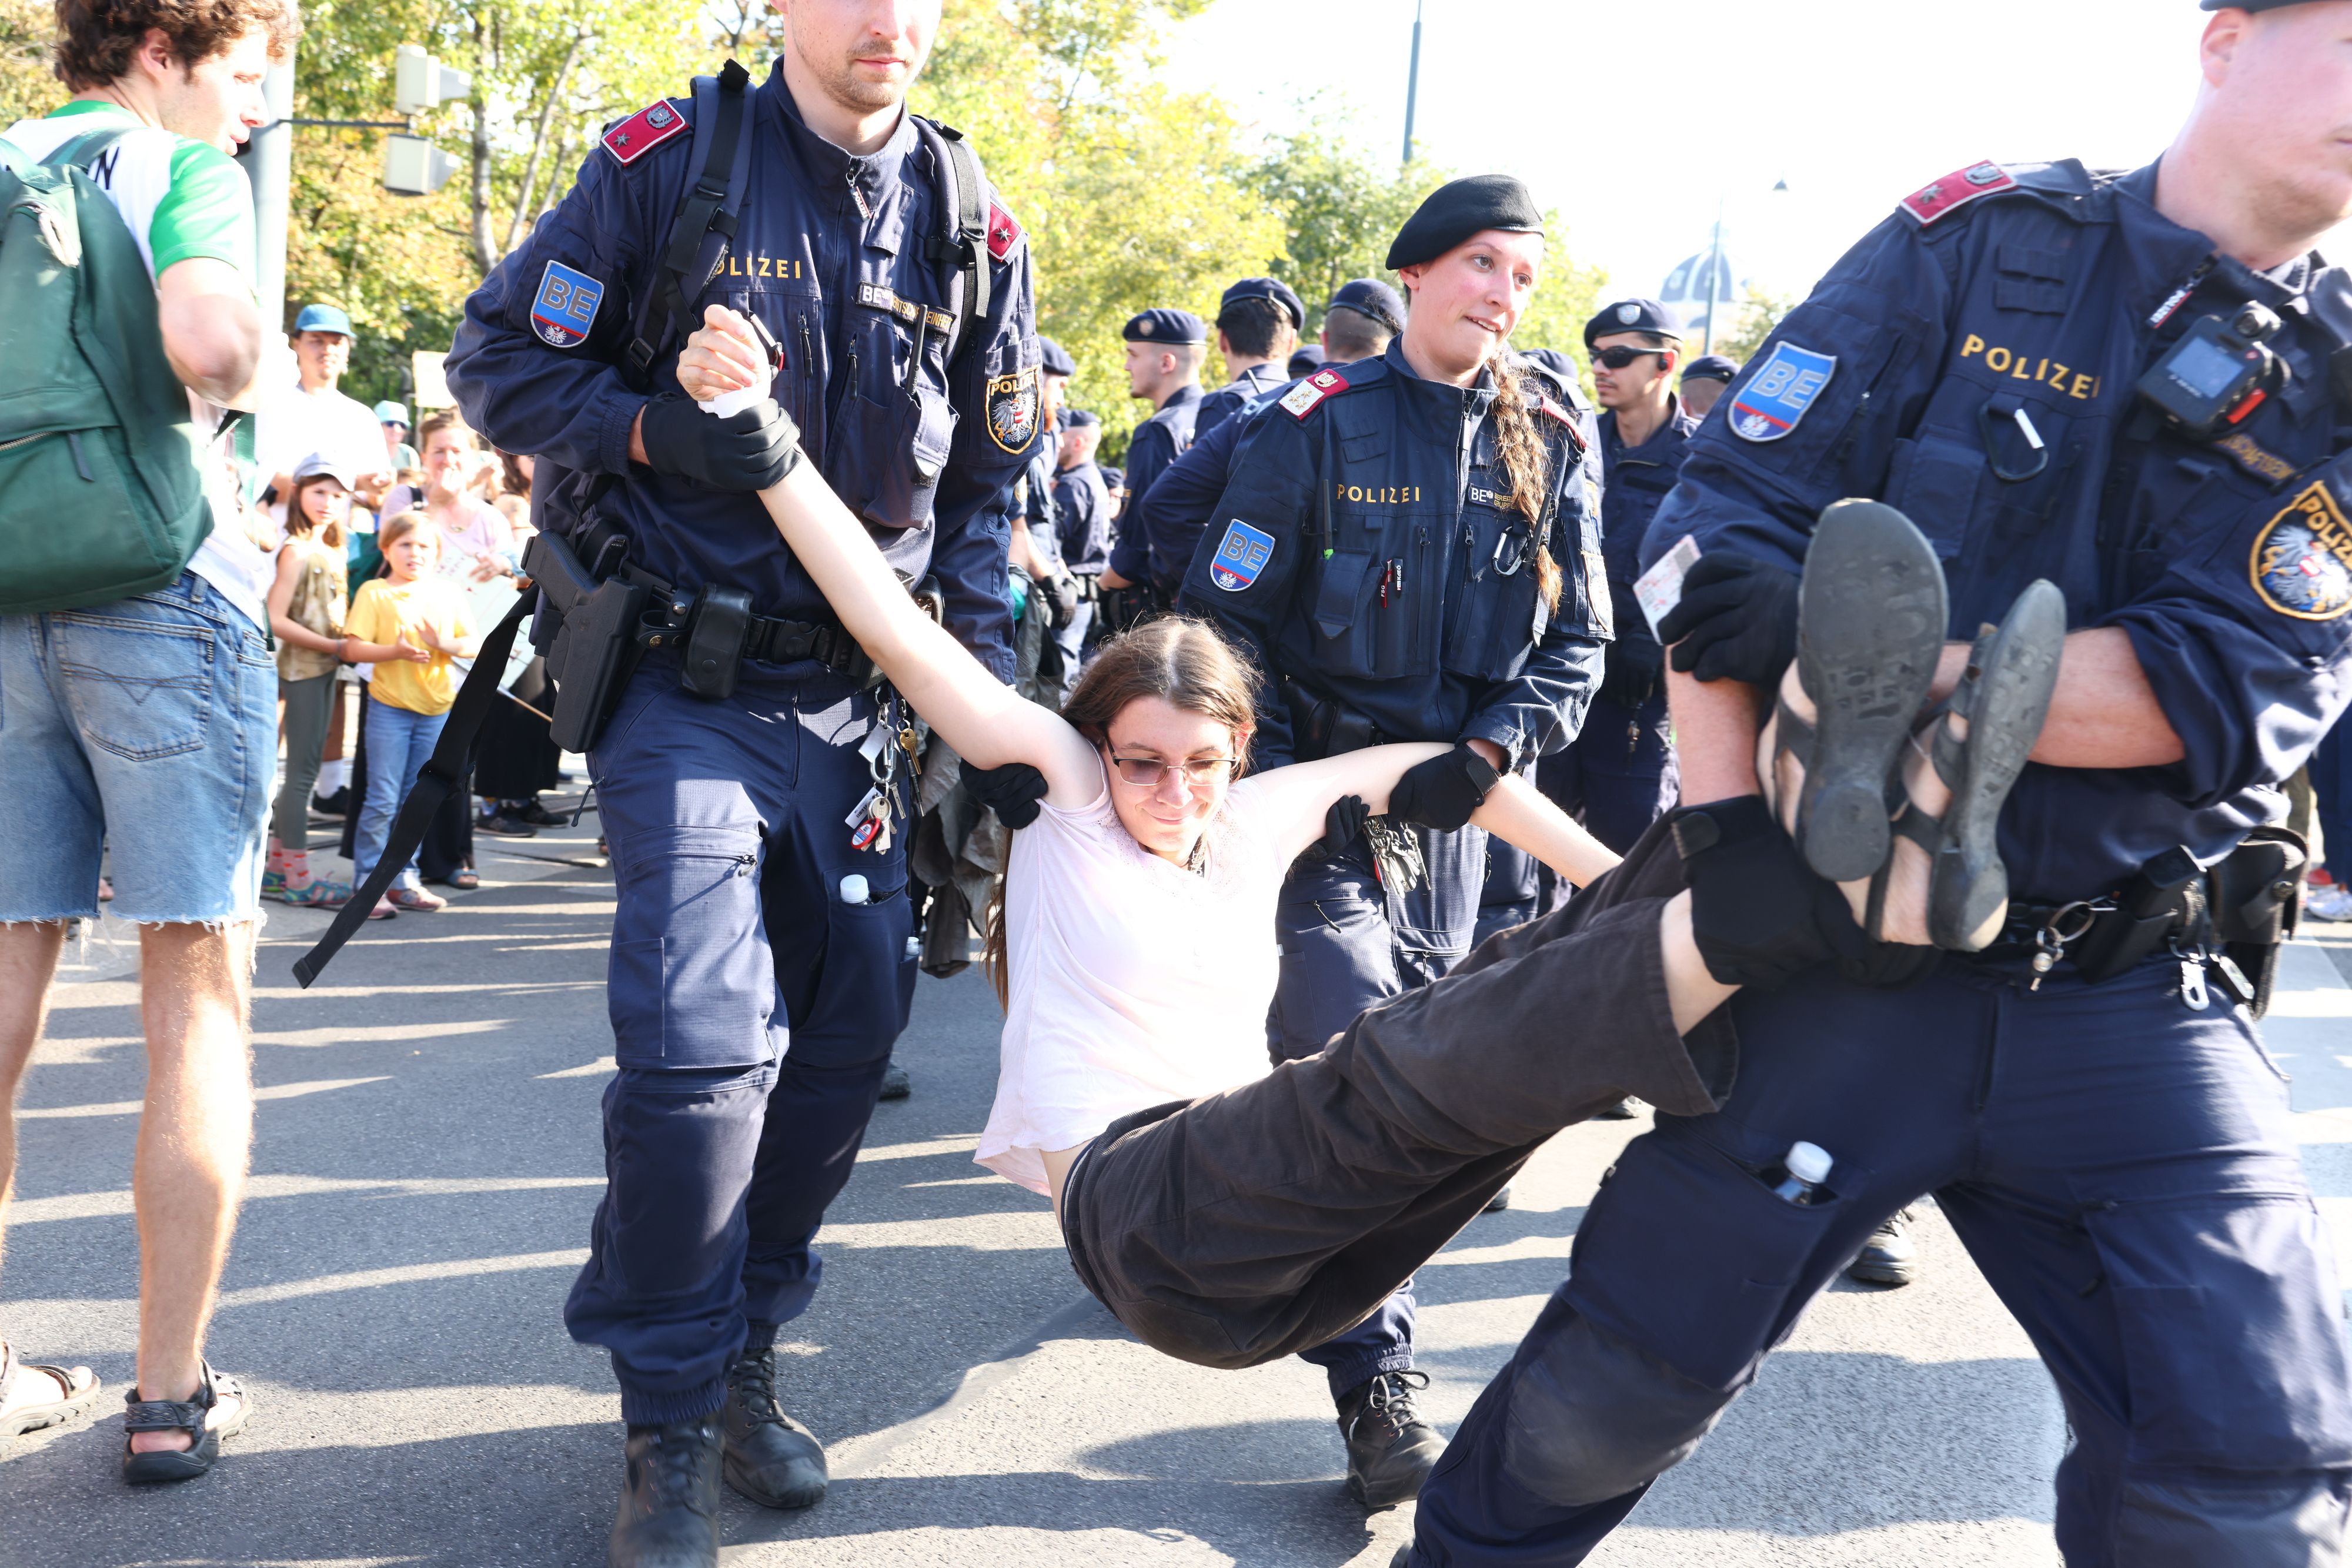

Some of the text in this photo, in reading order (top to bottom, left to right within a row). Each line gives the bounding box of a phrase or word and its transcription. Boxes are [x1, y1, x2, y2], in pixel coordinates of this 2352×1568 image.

[540, 274, 598, 323] BE
[862, 285, 883, 304] BE
[1749, 359, 1827, 410] BE
[1960, 333, 2101, 400] POLIZEI
[1337, 484, 1420, 504] POLIZEI
[1471, 487, 1487, 503] BE
[1221, 530, 1268, 571] BE
